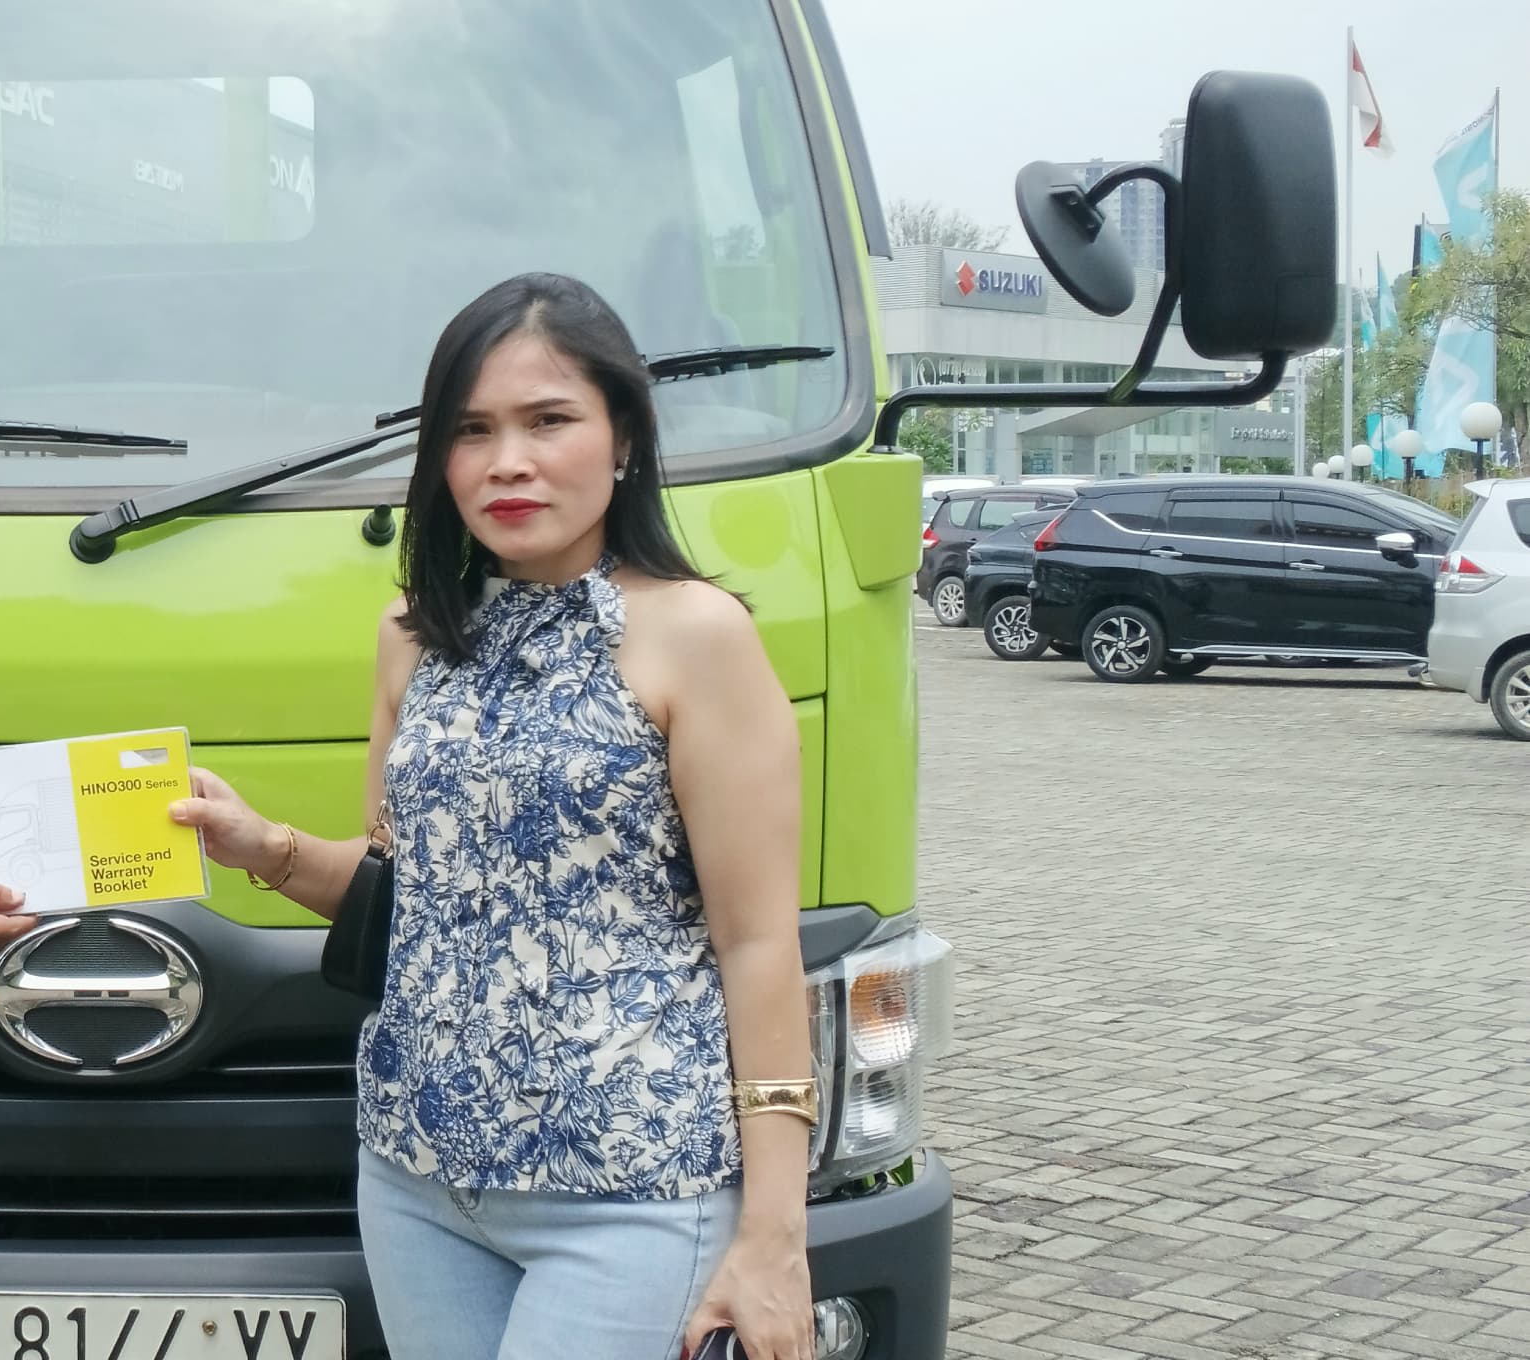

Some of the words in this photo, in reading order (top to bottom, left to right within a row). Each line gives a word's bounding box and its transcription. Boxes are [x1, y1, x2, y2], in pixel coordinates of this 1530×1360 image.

[978, 269, 1042, 296] SUZUKI
[80, 778, 142, 796] HINO300
[145, 779, 179, 790] Series
[90, 852, 142, 867] Service
[145, 847, 172, 861] and
[91, 865, 155, 880] Warranty
[93, 878, 148, 894] Booklet
